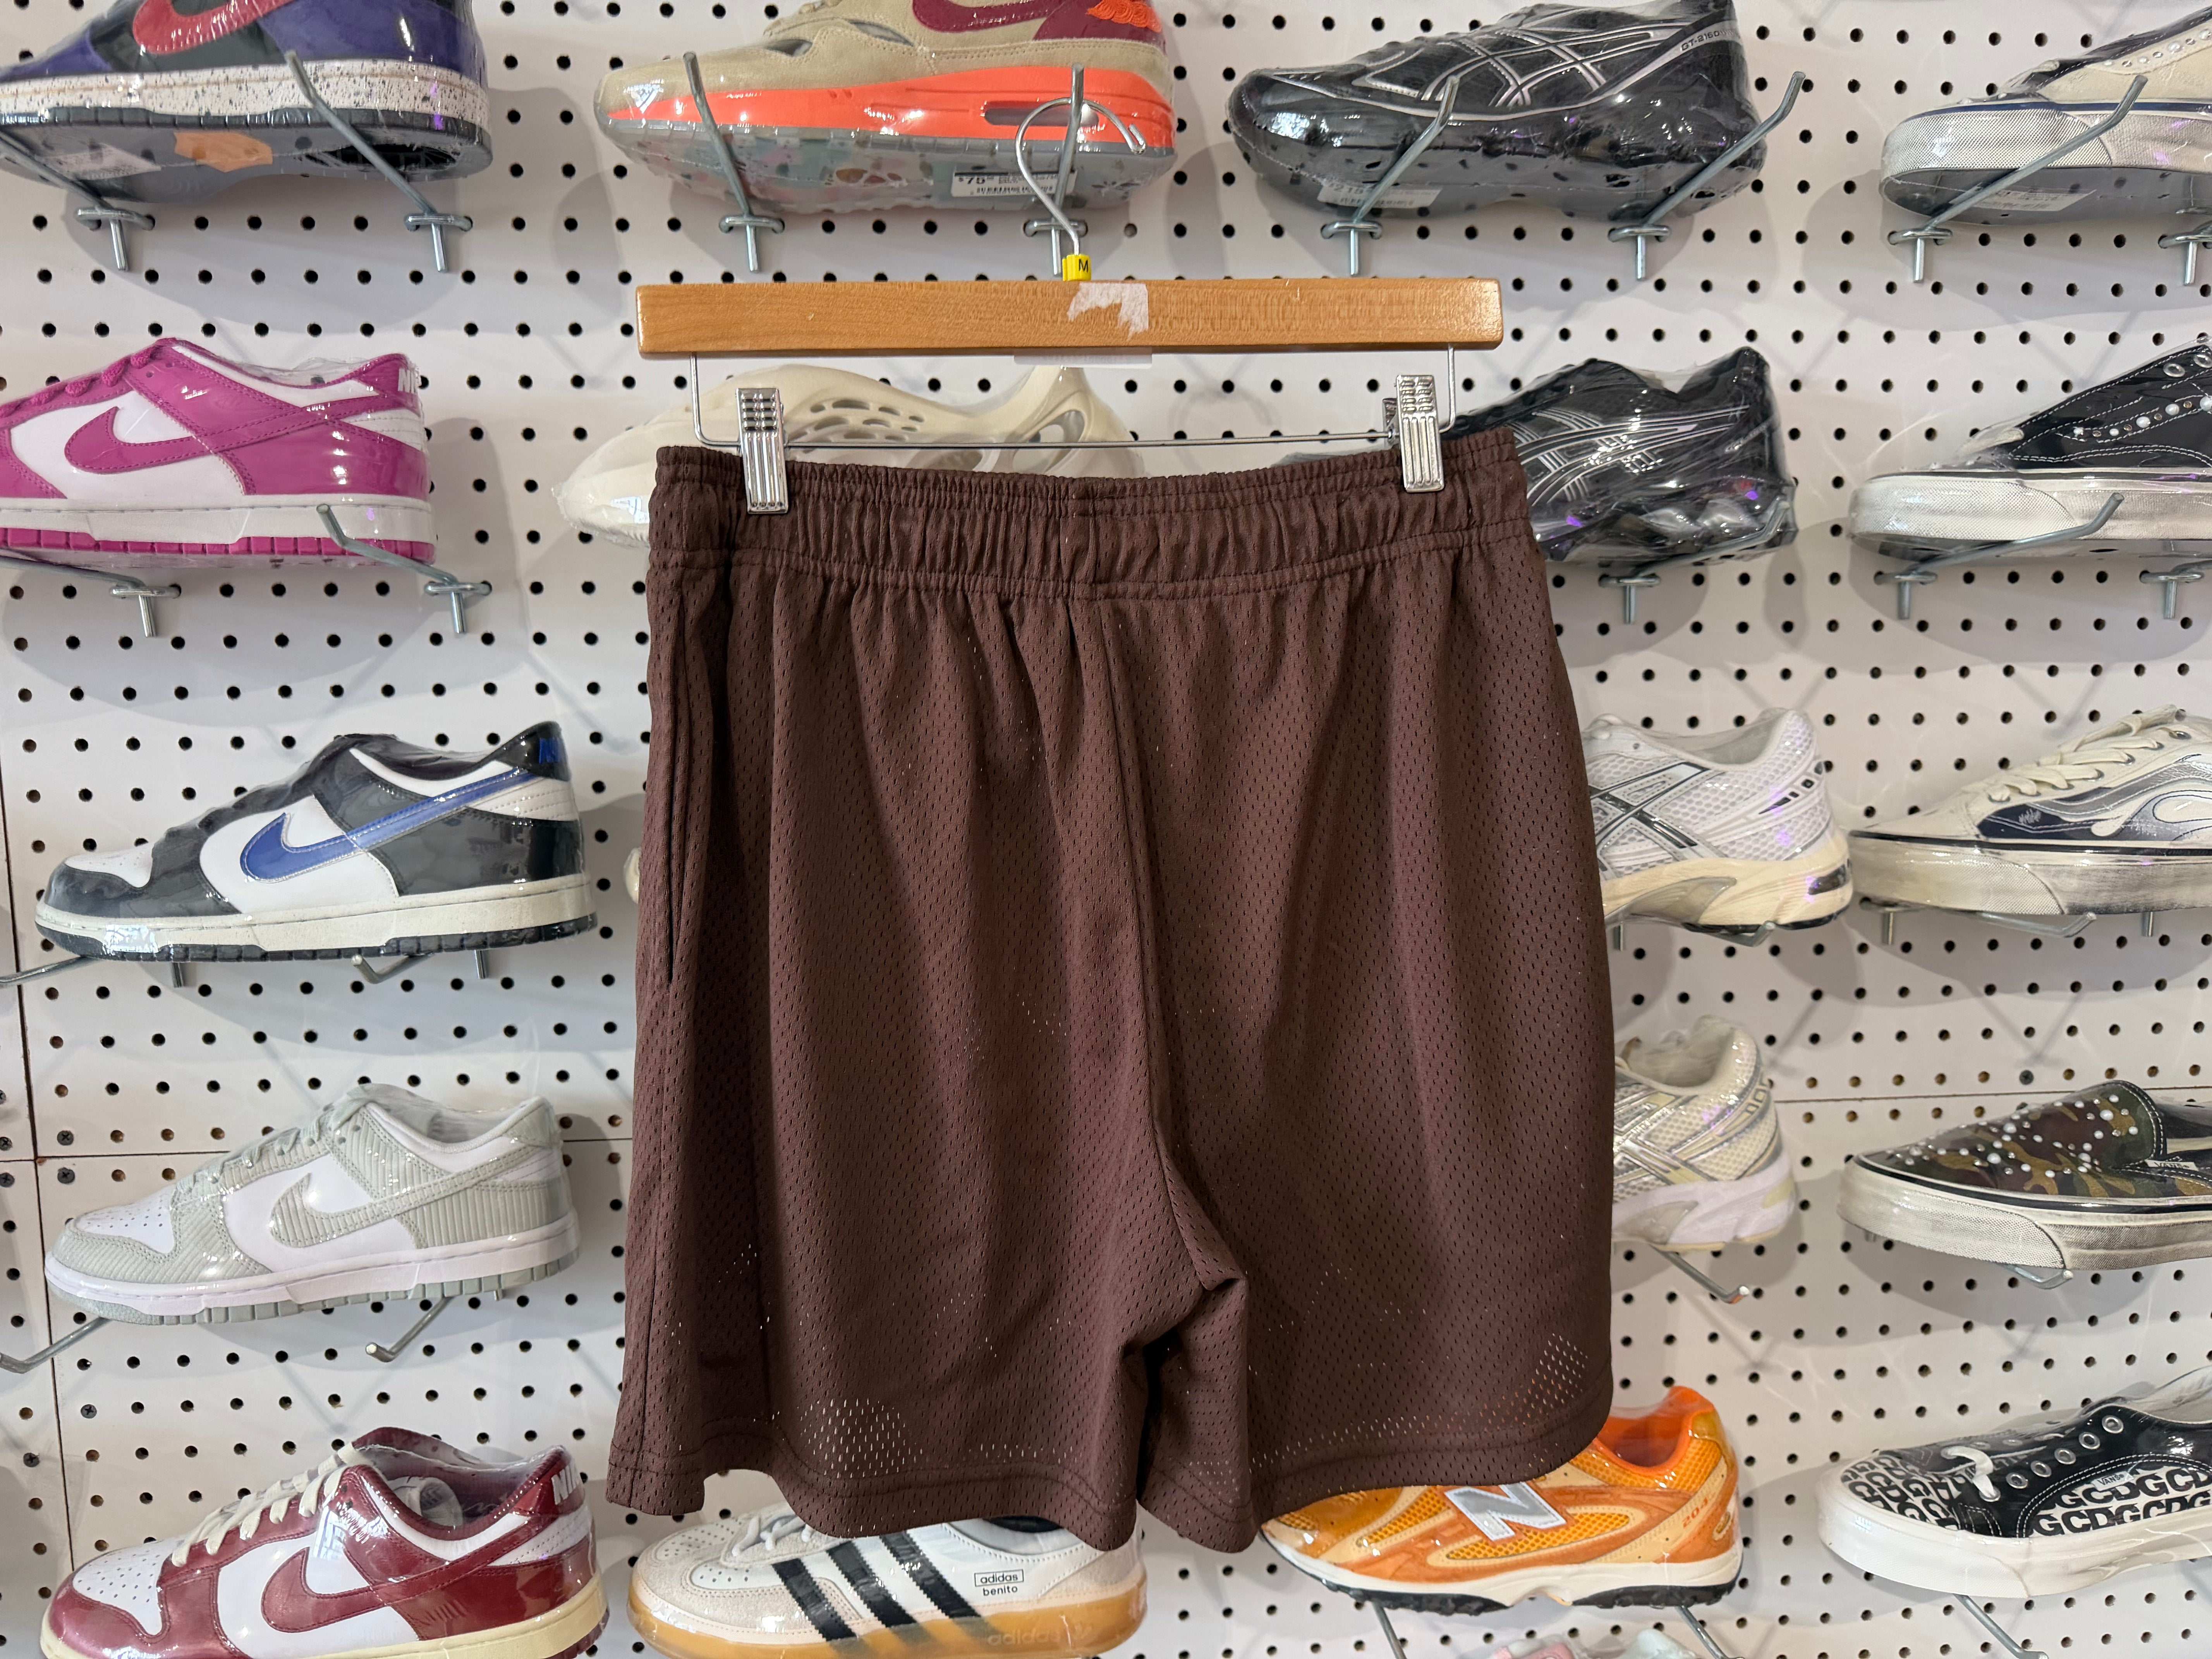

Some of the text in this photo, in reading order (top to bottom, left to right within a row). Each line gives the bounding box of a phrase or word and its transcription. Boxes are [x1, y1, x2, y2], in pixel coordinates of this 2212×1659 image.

[1079, 259, 1088, 273] M
[980, 1572, 1018, 1584] adidas
[982, 1585, 1018, 1596] benito
